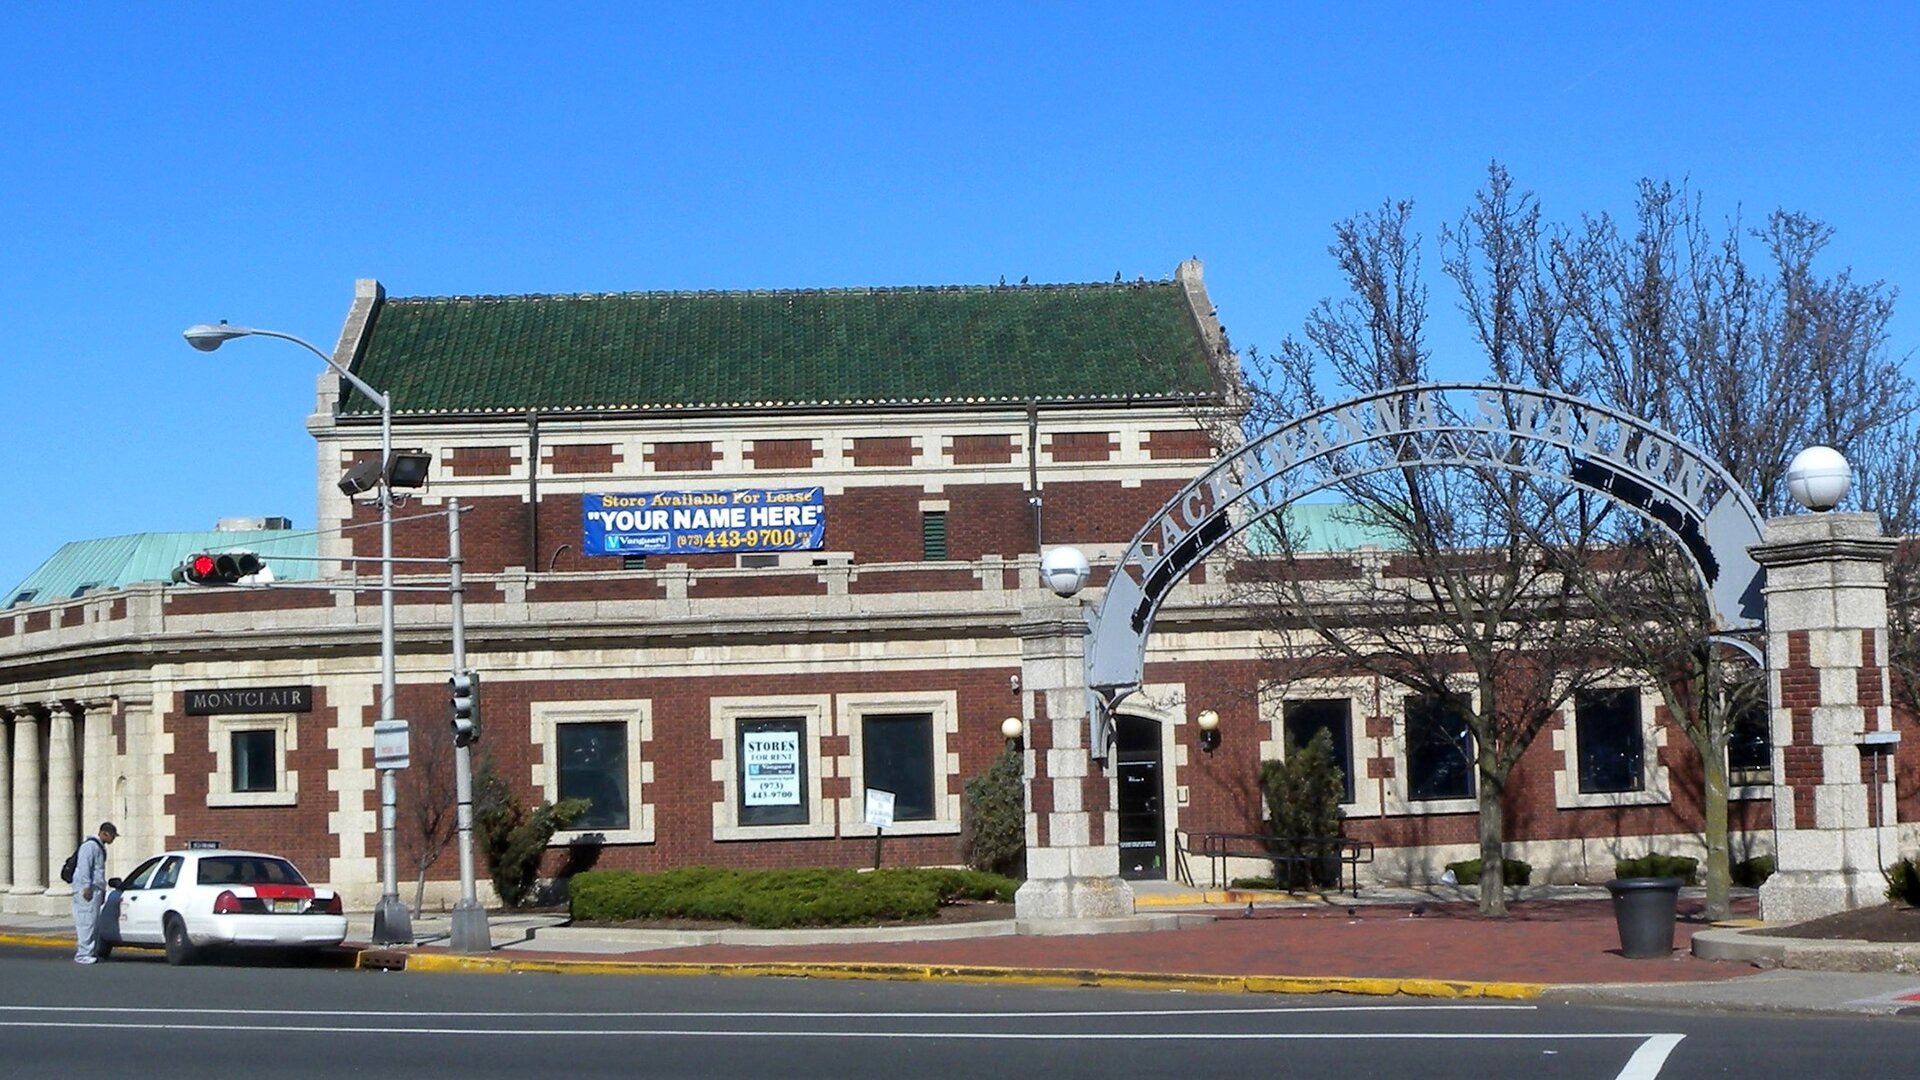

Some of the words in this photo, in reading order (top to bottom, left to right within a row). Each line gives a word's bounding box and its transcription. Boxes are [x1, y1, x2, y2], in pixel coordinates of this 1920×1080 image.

[1125, 389, 1437, 579] LACKAWANNA
[1474, 389, 1711, 504] STATION
[602, 495, 646, 508] Store
[650, 493, 728, 506] Available
[732, 492, 760, 504] For
[765, 491, 813, 503] Lease
[587, 510, 670, 531] "YOUR
[673, 508, 747, 530] NAME
[620, 536, 667, 546] Vanguard
[677, 534, 703, 549] (973)
[704, 528, 795, 549] 443-9700
[193, 690, 302, 708] MONTCLAIR
[748, 741, 795, 752] STORES
[770, 753, 792, 761] RENT
[759, 782, 784, 790] (973)
[751, 791, 793, 799] 443-9700
